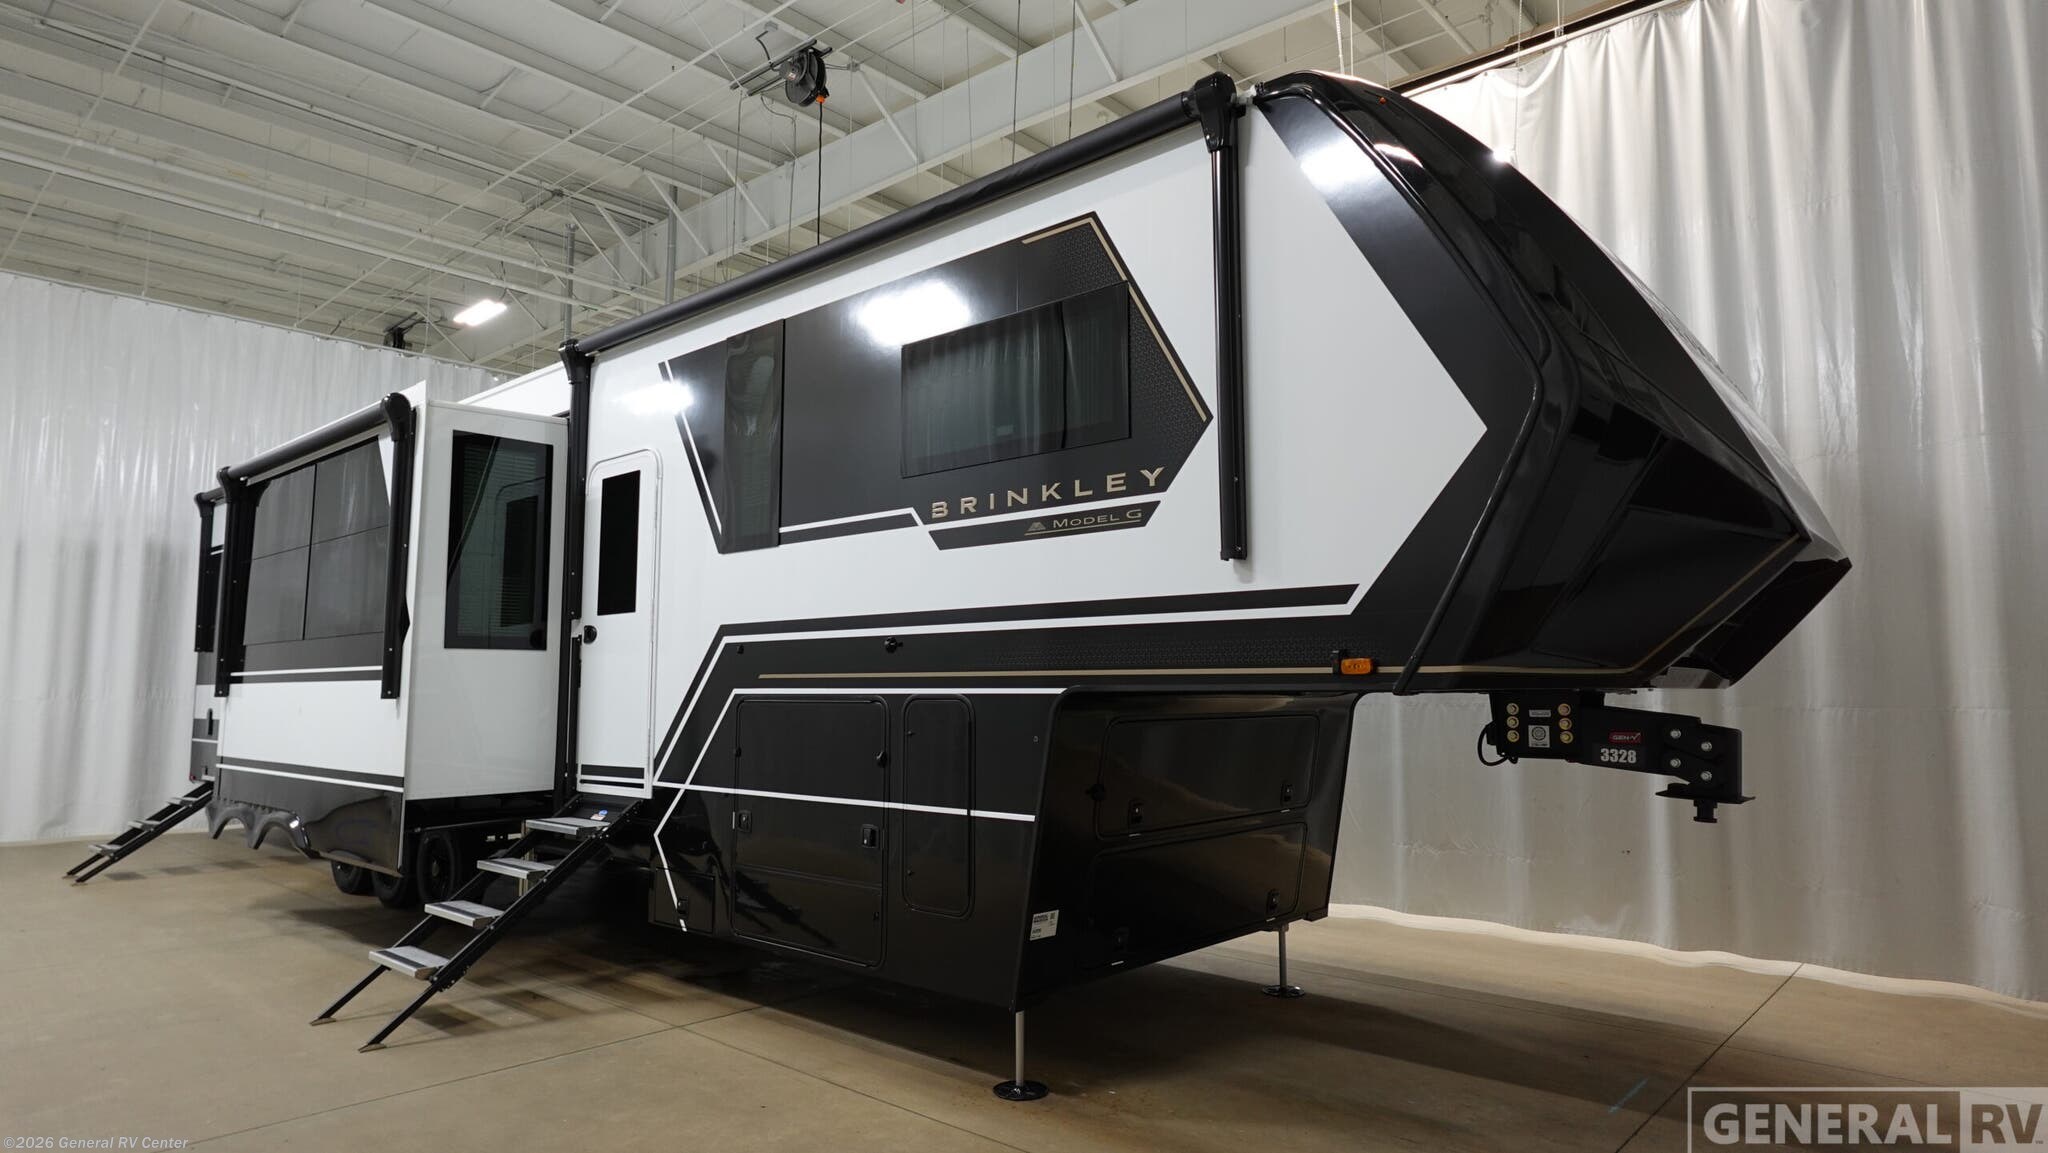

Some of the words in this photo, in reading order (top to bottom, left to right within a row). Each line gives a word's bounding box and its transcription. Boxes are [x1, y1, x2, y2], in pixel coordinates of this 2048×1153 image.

[931, 466, 1165, 519] BRINKLEY
[1126, 508, 1142, 520] G
[1600, 748, 1637, 764] 3328
